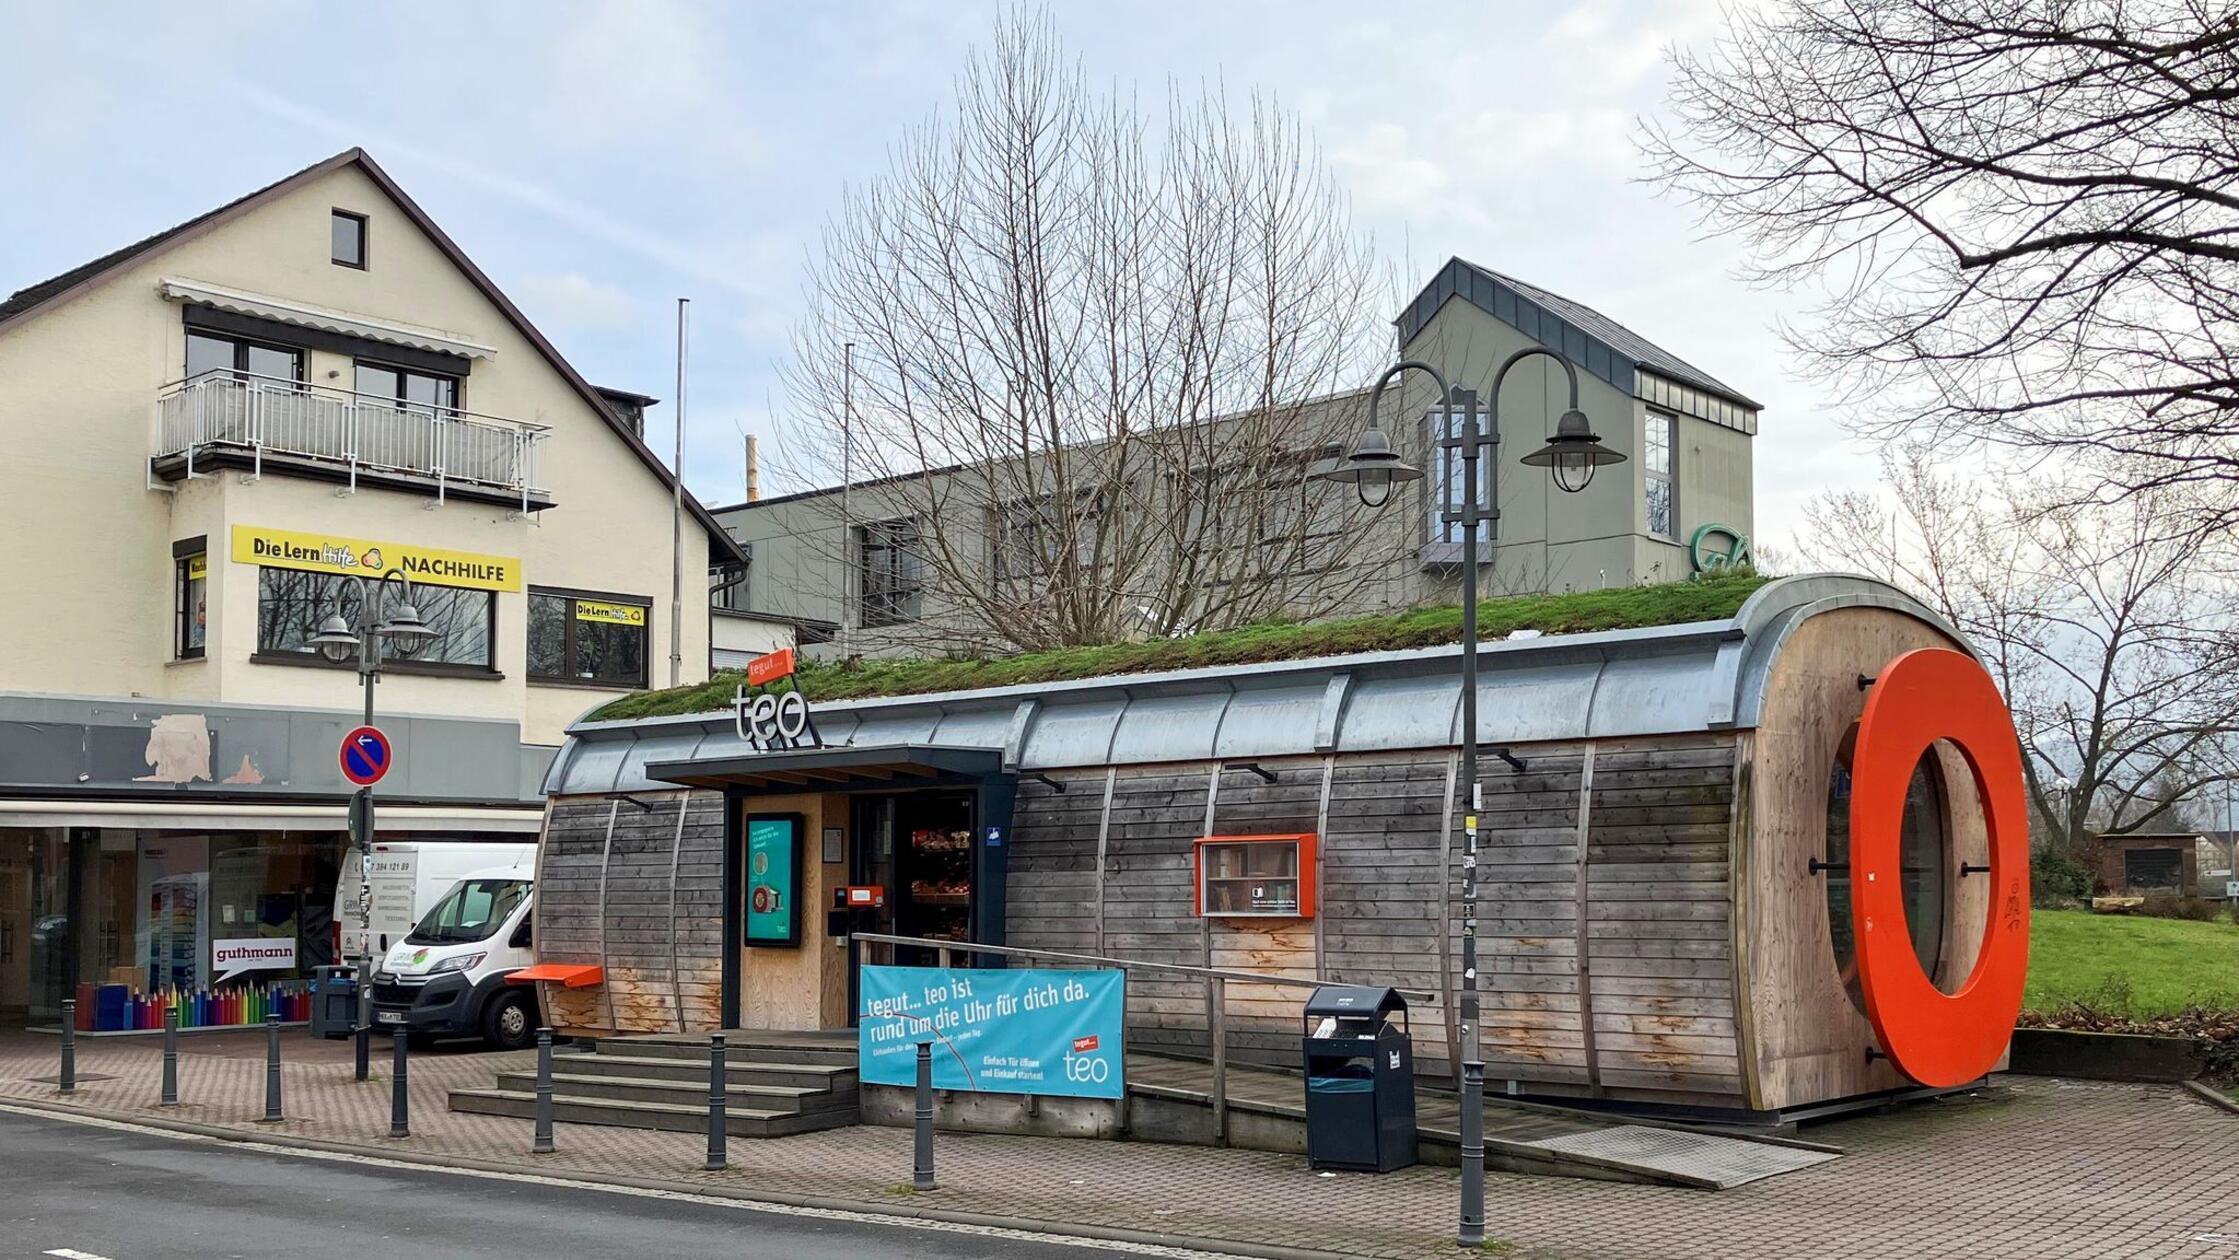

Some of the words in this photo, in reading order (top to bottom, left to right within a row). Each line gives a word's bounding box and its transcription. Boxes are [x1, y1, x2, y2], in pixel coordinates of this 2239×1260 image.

[321, 543, 358, 569] Hilfe
[402, 555, 504, 582] NACHHILFE
[730, 684, 806, 742] teo
[216, 947, 293, 962] guthmann
[867, 992, 921, 1018] tegut...
[924, 986, 947, 1006] teo
[951, 977, 973, 999] ist
[870, 1016, 906, 1043] rund
[909, 1016, 932, 1035] um
[935, 1006, 960, 1029] die
[964, 1000, 992, 1024] Uhr
[996, 993, 1018, 1017] für
[1023, 983, 1059, 1011] dich
[1063, 978, 1090, 1002] da.
[980, 1069, 993, 1078] und
[993, 1069, 1018, 1079] Einkauf
[983, 1055, 1007, 1066] Einfach
[1008, 1056, 1019, 1067] Tür
[1062, 1050, 1108, 1083] teo
